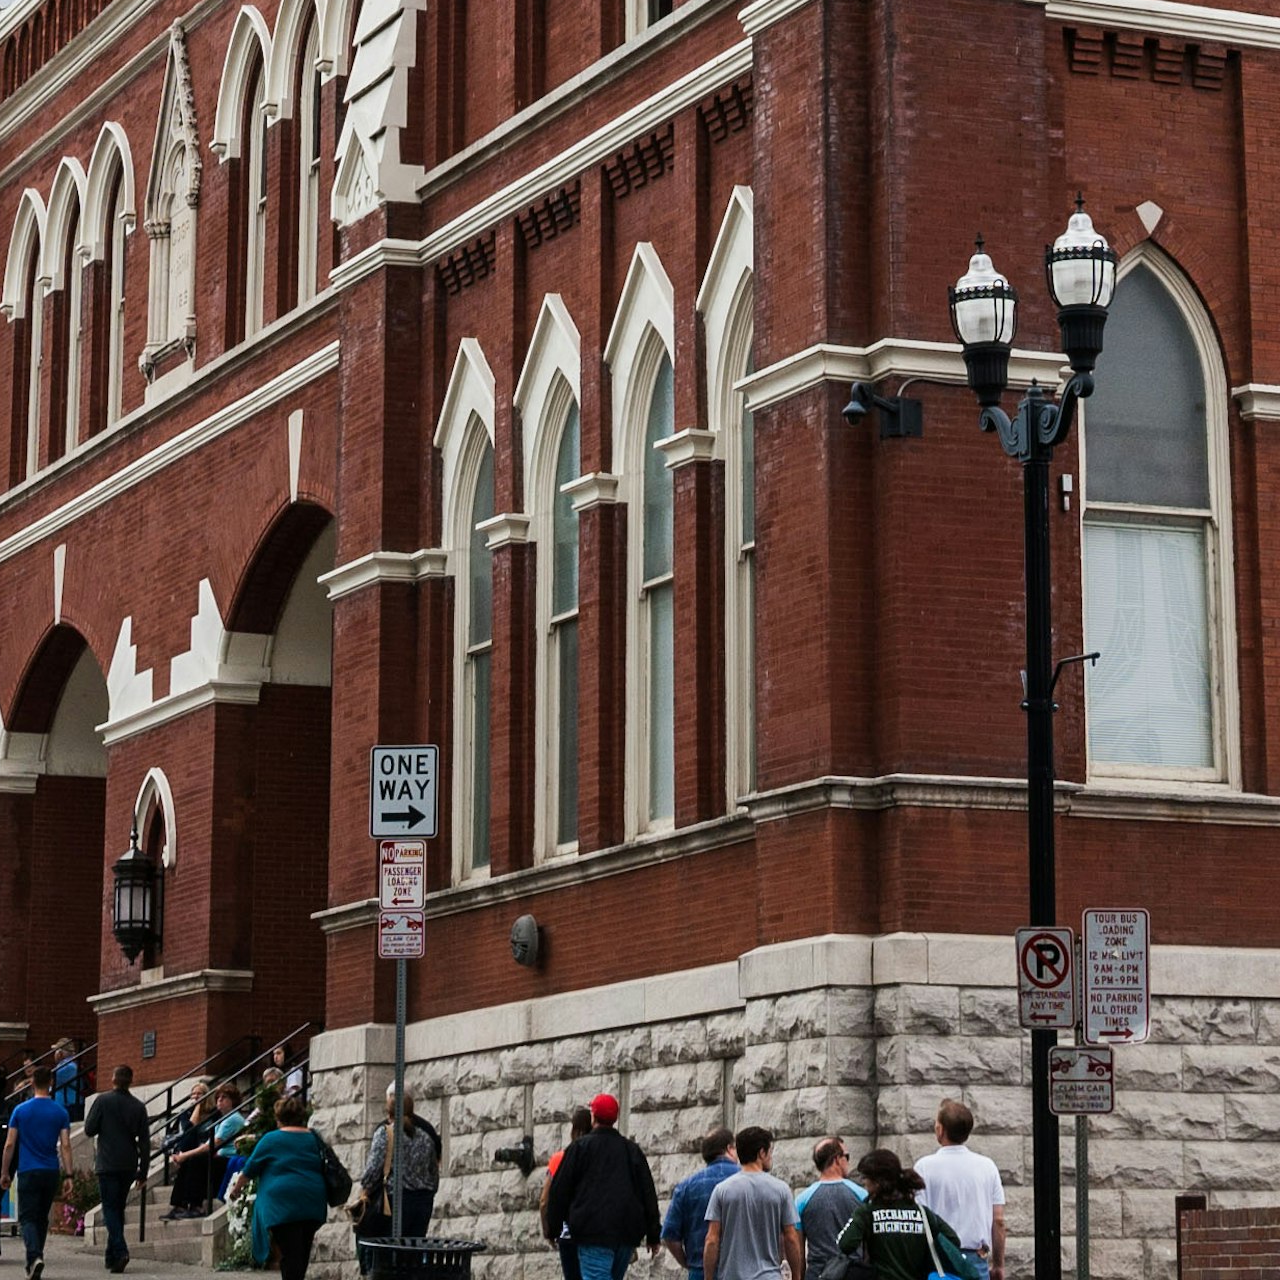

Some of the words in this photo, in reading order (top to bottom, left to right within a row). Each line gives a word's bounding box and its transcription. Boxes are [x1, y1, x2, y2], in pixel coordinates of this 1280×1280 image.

[381, 754, 428, 775] ONE
[379, 779, 430, 800] WAY
[382, 847, 395, 861] NO
[395, 848, 423, 858] PARKING
[384, 867, 422, 876] PASSENGER
[393, 887, 412, 896] ZONE
[1094, 914, 1117, 923] TOUR
[1120, 914, 1138, 923] BUS
[1104, 937, 1127, 946] ZONE
[1089, 951, 1098, 960] 12
[1090, 994, 1103, 1002] NO
[1106, 994, 1143, 1003] PARKING
[1030, 1001, 1046, 1010] ANY
[1048, 1001, 1065, 1010] TIME
[1091, 1005, 1108, 1015] ALL
[1110, 1005, 1138, 1015] OTHER
[1104, 1017, 1130, 1026] TIMES
[1058, 1084, 1085, 1092] CLAIM
[1086, 1084, 1105, 1092] CAR
